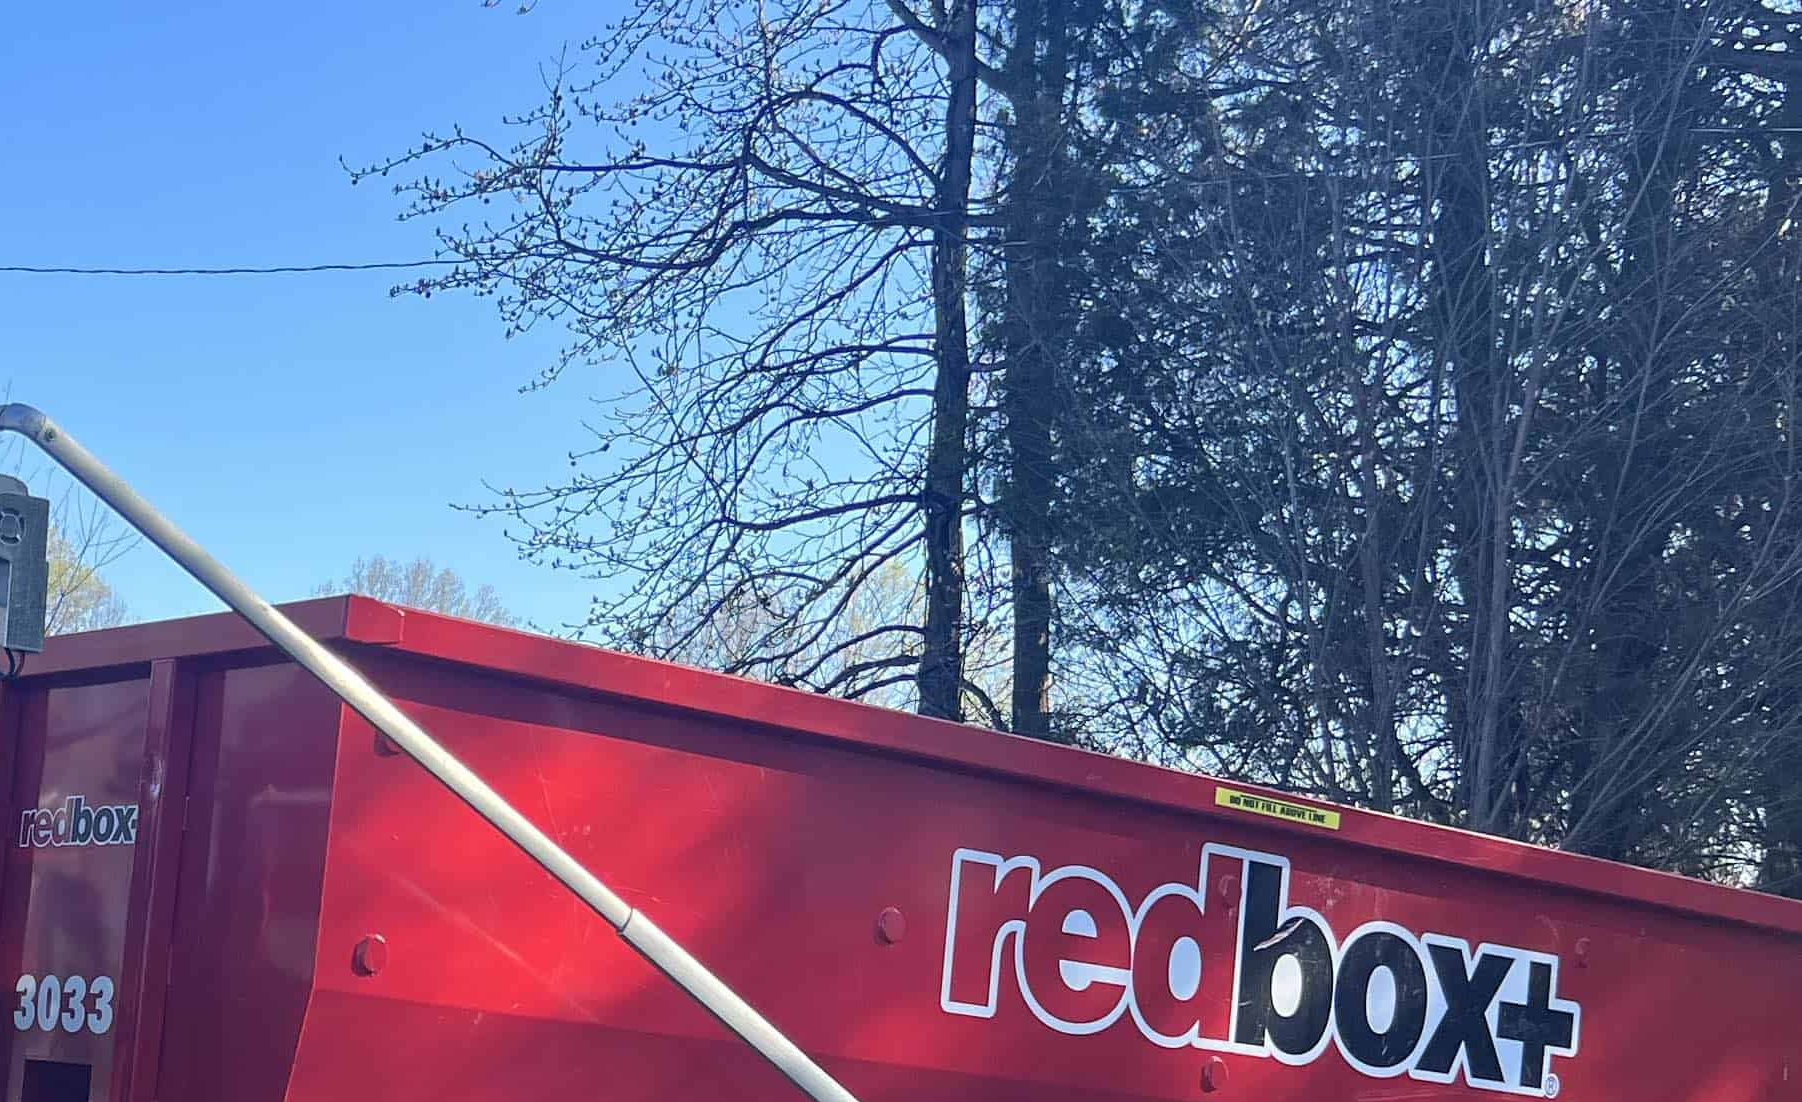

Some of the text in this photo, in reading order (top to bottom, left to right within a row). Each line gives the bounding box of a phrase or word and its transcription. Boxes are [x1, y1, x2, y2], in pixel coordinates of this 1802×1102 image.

[1242, 797, 1259, 809] NOT
[941, 843, 1581, 1099] redbox+
[13, 974, 115, 1034] 3033
